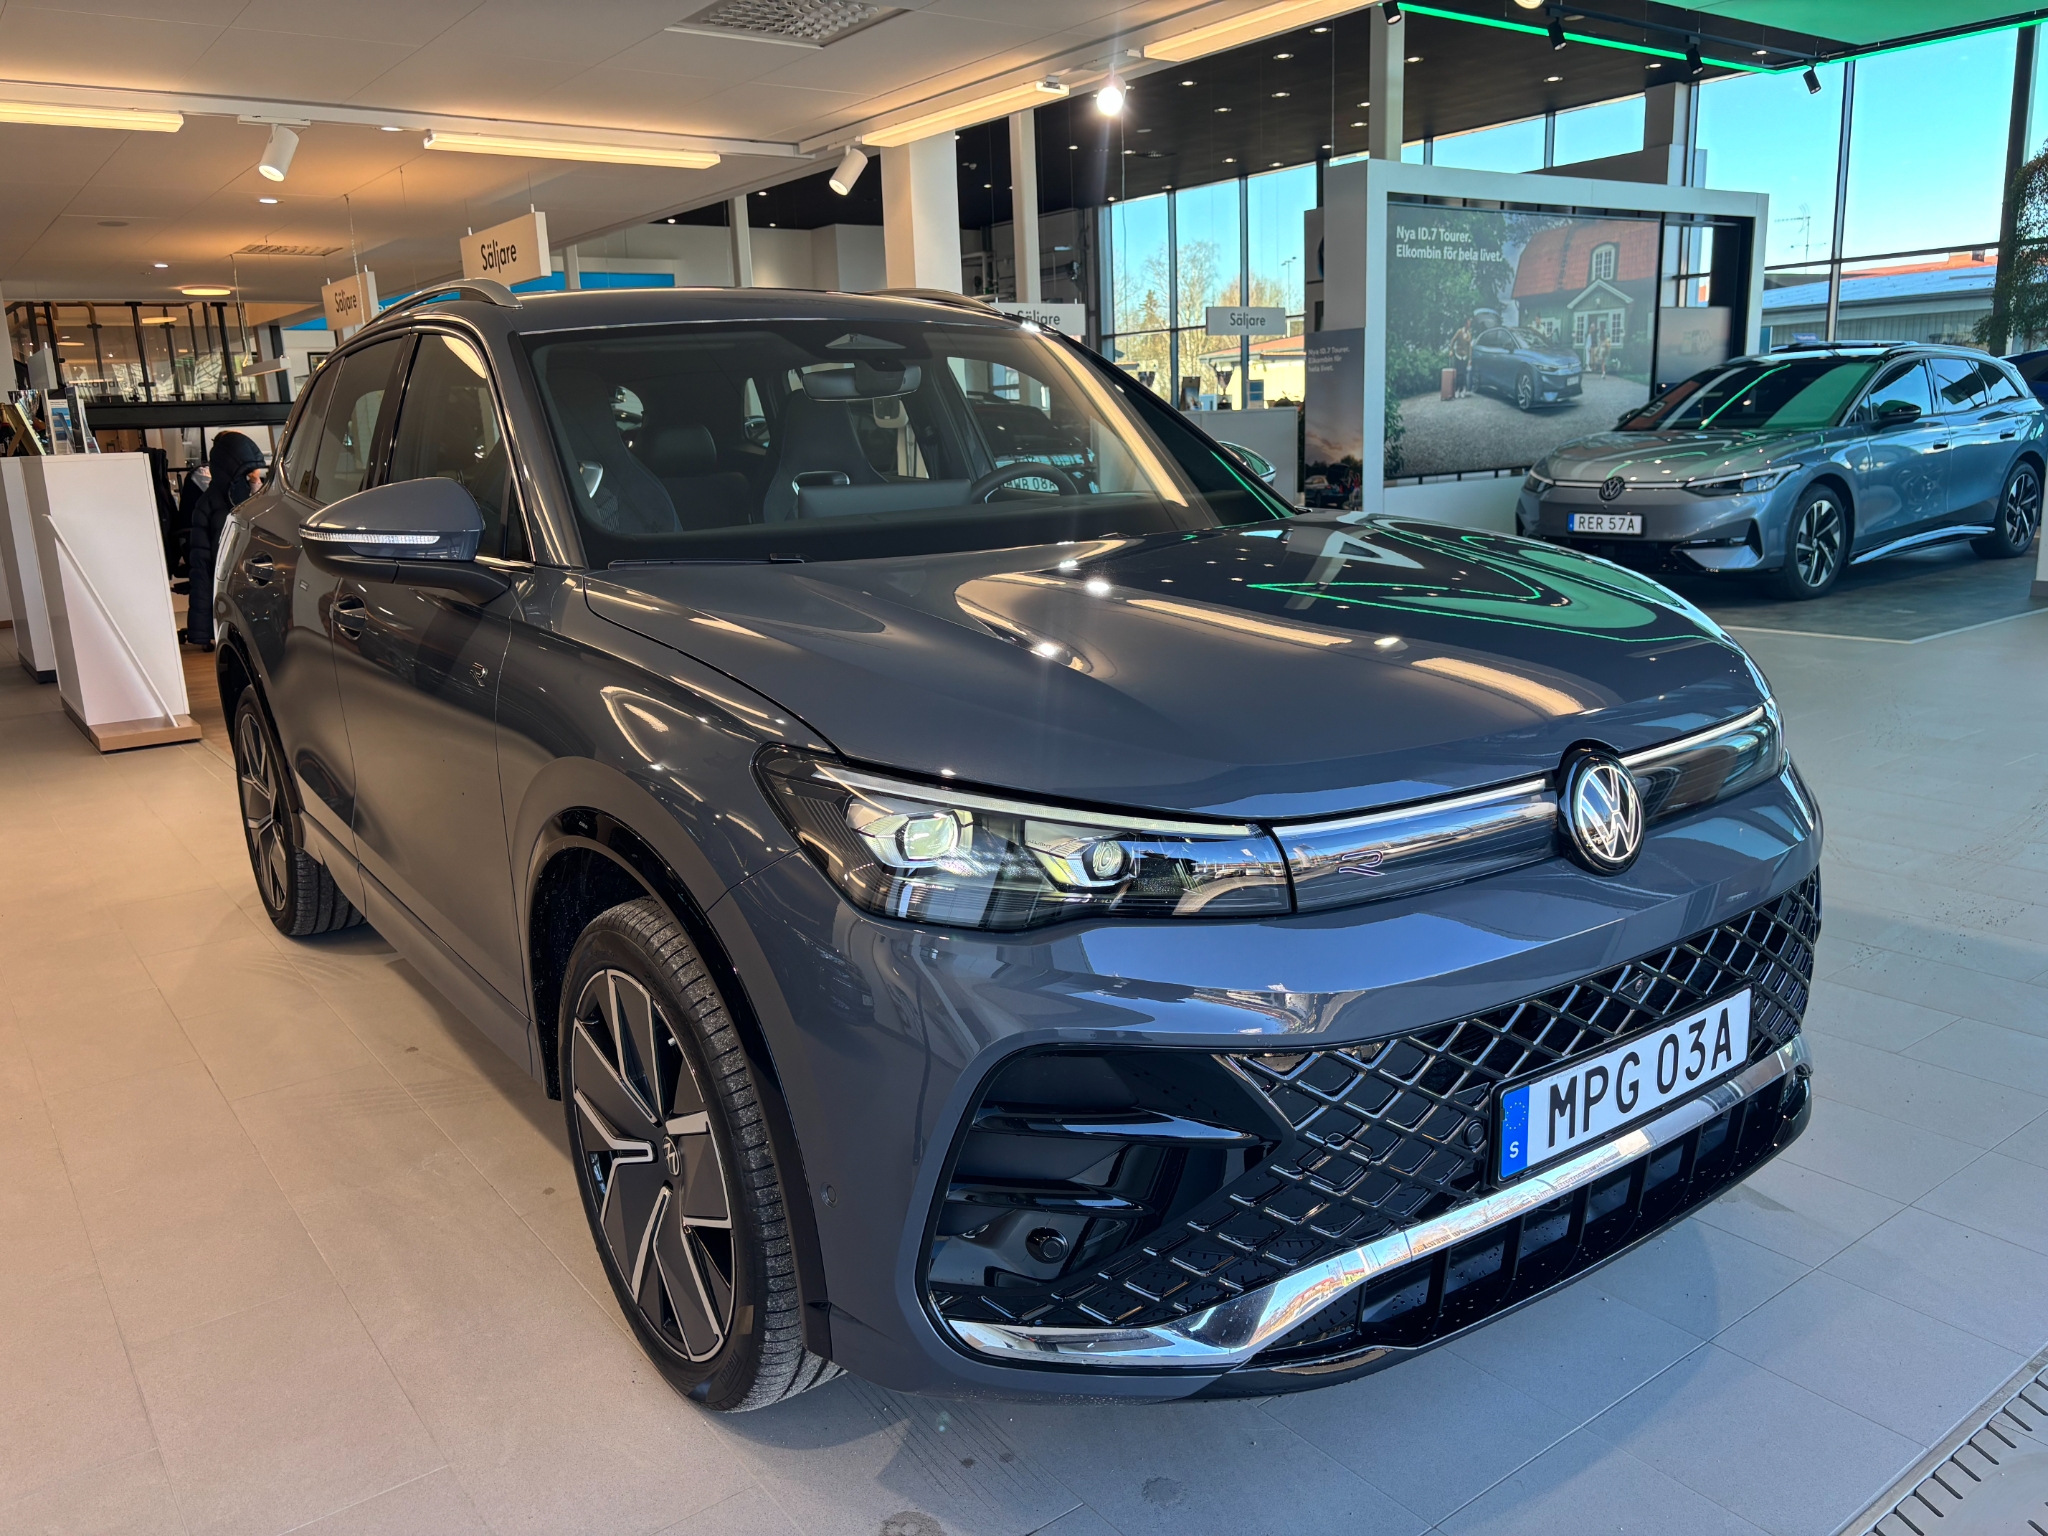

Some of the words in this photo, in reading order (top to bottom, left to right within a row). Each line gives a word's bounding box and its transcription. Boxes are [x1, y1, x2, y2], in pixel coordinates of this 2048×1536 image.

[1396, 225, 1416, 242] Nya
[1417, 227, 1437, 240] ID.7
[1439, 228, 1472, 243] Tourer.
[480, 239, 517, 273] Säljare
[1396, 244, 1441, 259] Elkombin
[1443, 245, 1458, 260] för
[1480, 248, 1503, 262] livet.
[334, 289, 358, 315] Säljare
[1230, 312, 1266, 329] Säljare
[1578, 515, 1604, 530] RER
[1608, 517, 1635, 531] 57A
[1548, 1051, 1641, 1149] MPG
[1657, 1007, 1732, 1095] 03A
[1509, 1141, 1519, 1159] S
